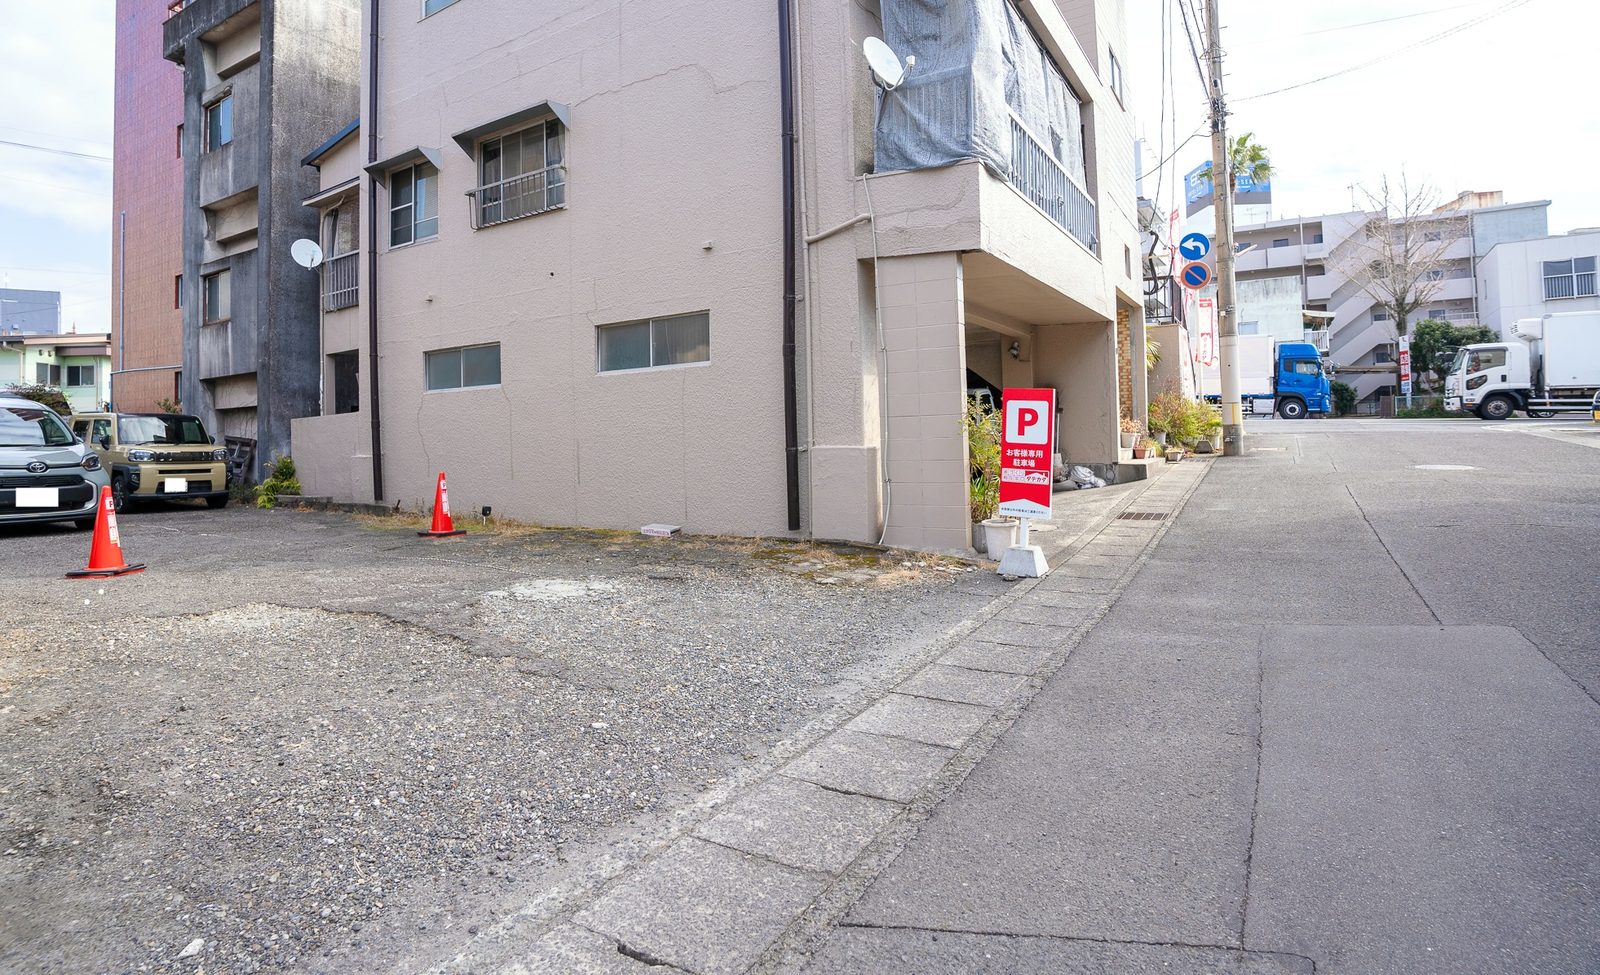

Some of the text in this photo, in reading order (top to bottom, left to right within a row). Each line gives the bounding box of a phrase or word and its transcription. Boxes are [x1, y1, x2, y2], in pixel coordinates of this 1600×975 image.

[1018, 407, 1039, 436] P
[1006, 448, 1043, 459] お客様専用
[1012, 458, 1036, 468] 駐車場
